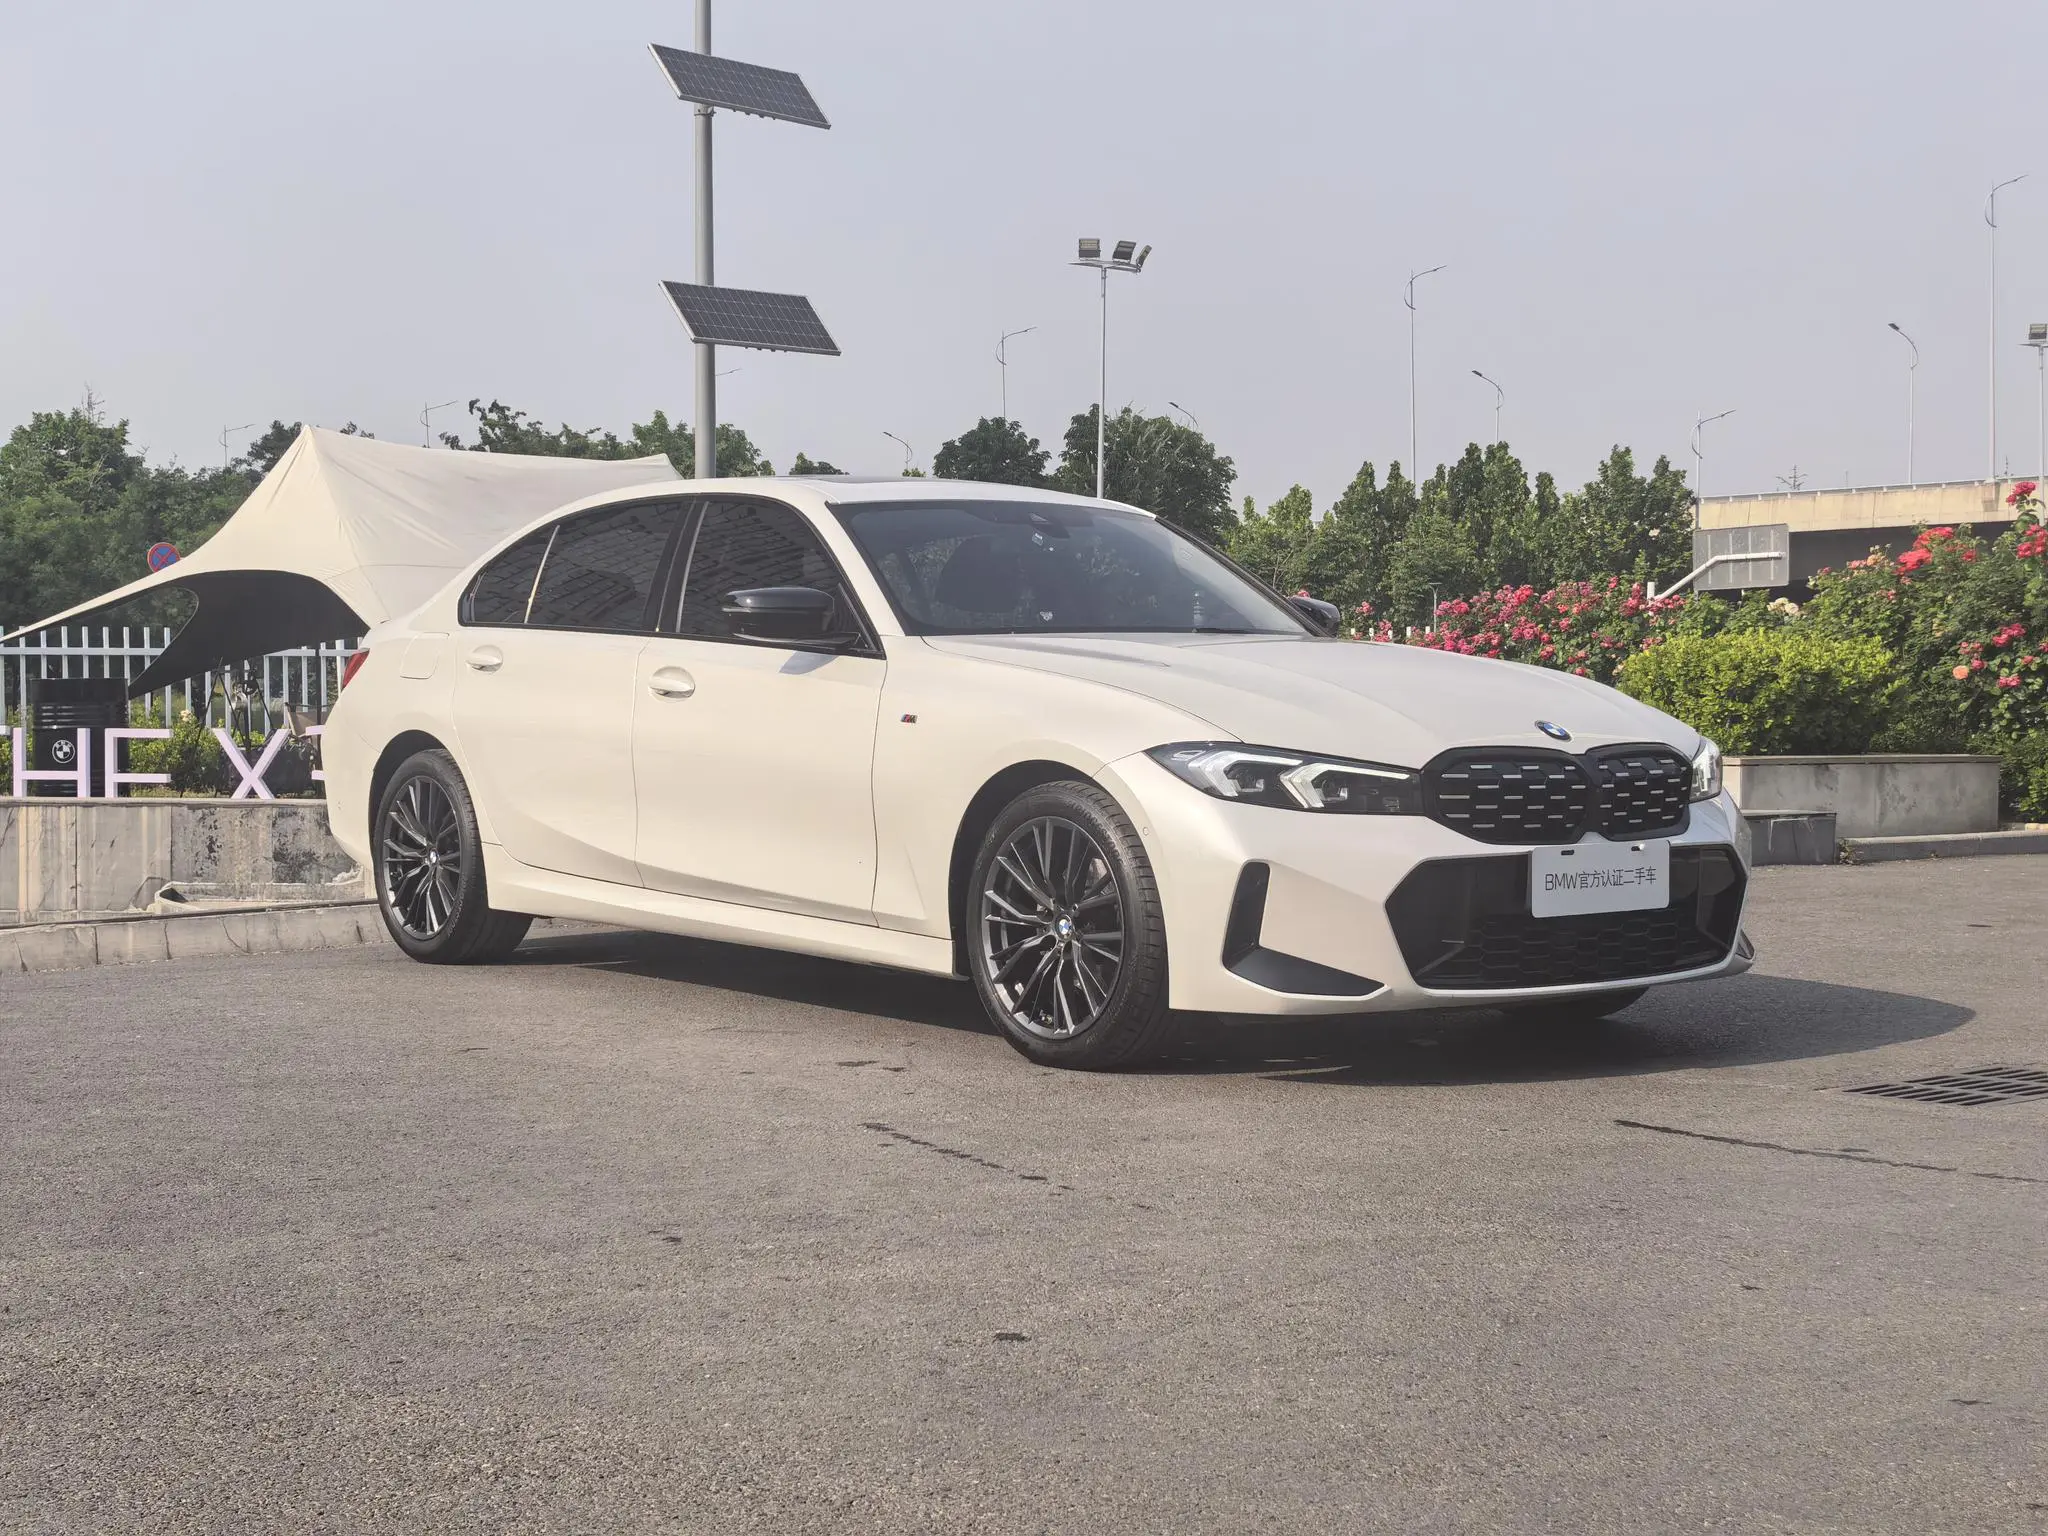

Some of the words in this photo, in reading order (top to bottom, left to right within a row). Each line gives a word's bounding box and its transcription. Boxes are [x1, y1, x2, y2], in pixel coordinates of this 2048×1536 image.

[1545, 866, 1657, 891] BMW官方认证二手车
